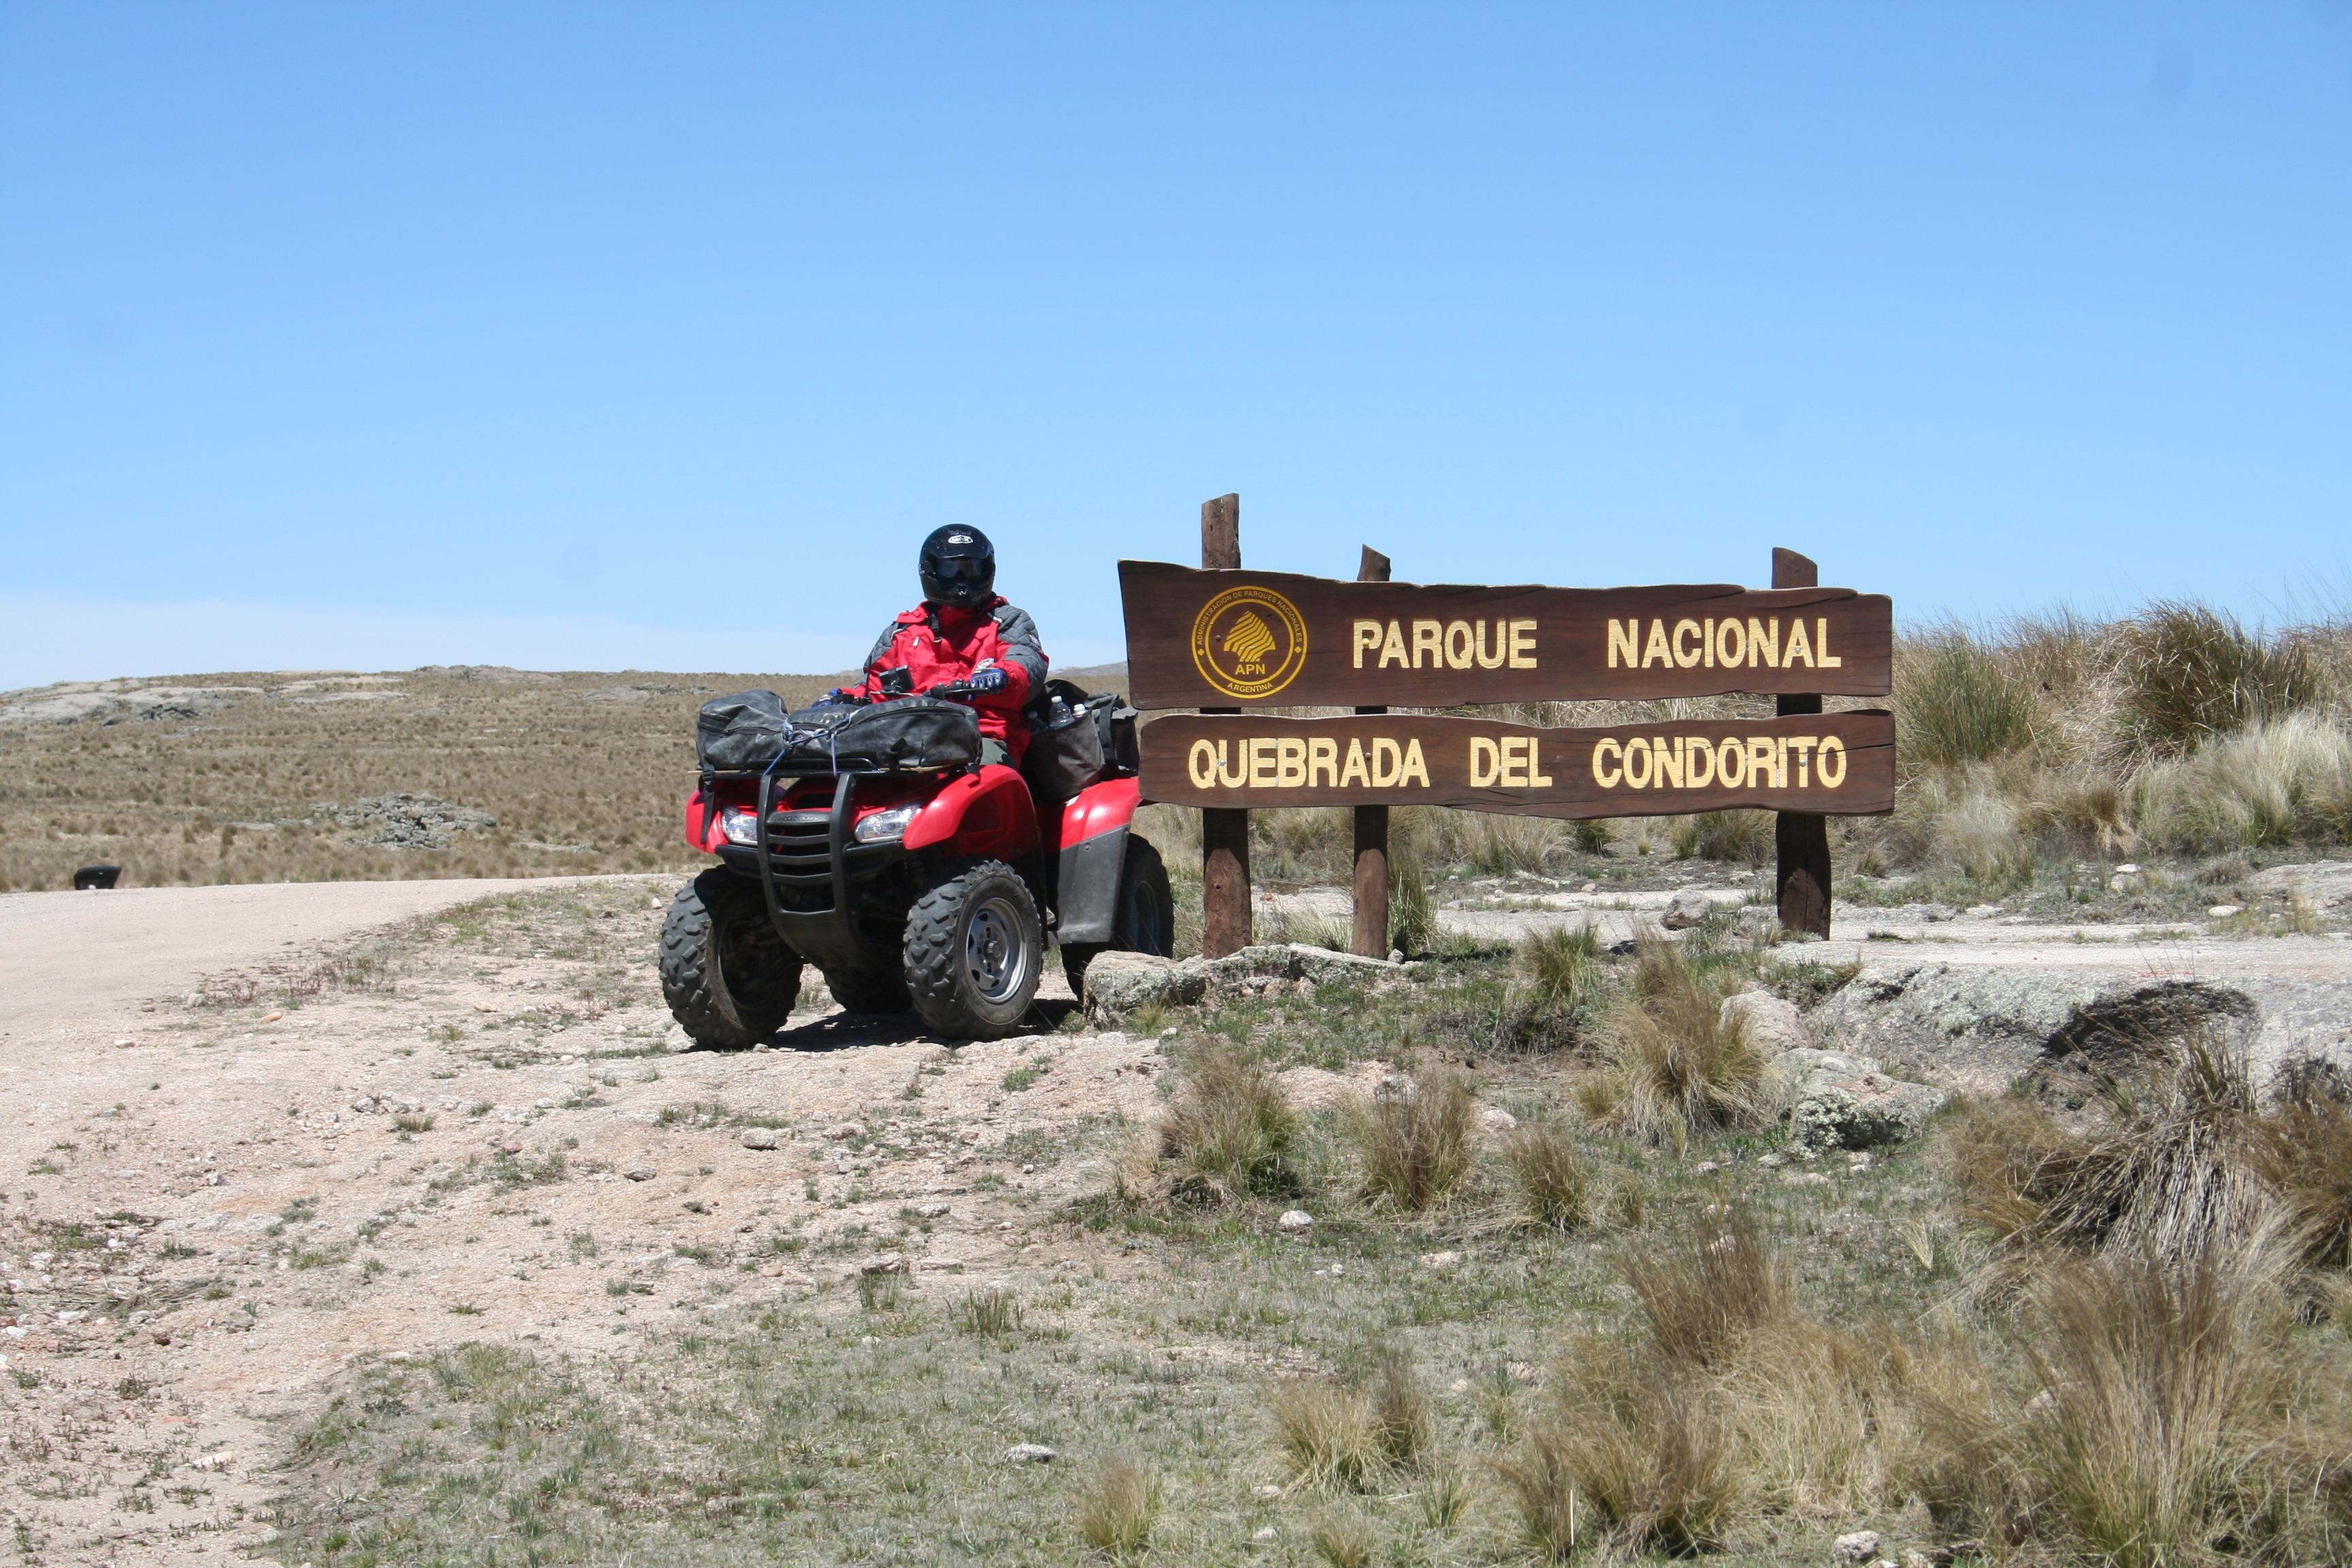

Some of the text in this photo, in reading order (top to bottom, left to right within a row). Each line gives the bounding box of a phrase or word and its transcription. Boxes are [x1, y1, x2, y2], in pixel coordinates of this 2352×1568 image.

[1197, 595, 1232, 646] ADMINISTRACION
[1244, 590, 1277, 603] PARQUES
[1277, 600, 1303, 643] NACIONALES
[1353, 617, 1842, 670] PARQUE NACIONAL
[1227, 682, 1273, 693] ARGENTINA
[1235, 664, 1266, 675] APN
[1188, 735, 1847, 789] QUEBRADA DEL CONDORITO
